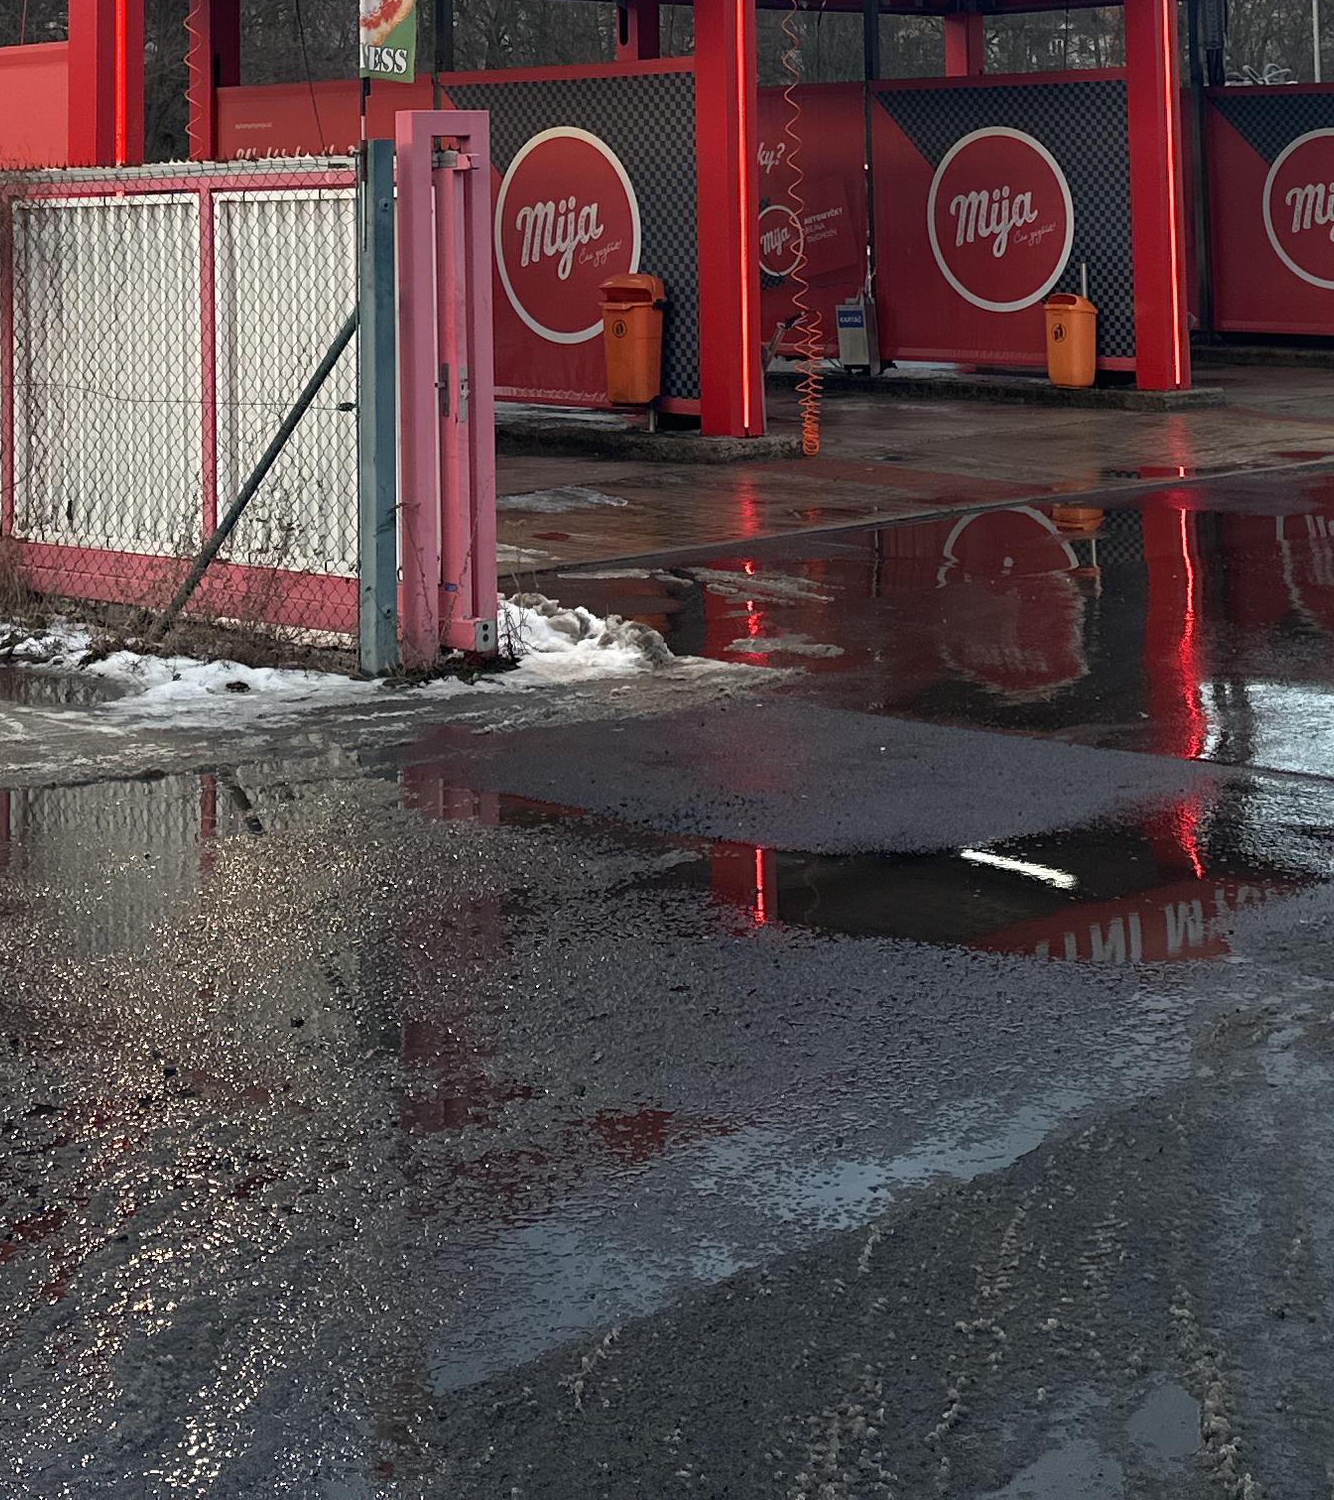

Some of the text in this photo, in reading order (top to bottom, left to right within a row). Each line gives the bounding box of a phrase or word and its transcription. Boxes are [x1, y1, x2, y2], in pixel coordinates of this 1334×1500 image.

[515, 195, 604, 281] Mija
[759, 226, 791, 256] Mija
[949, 185, 1039, 258] Mija
